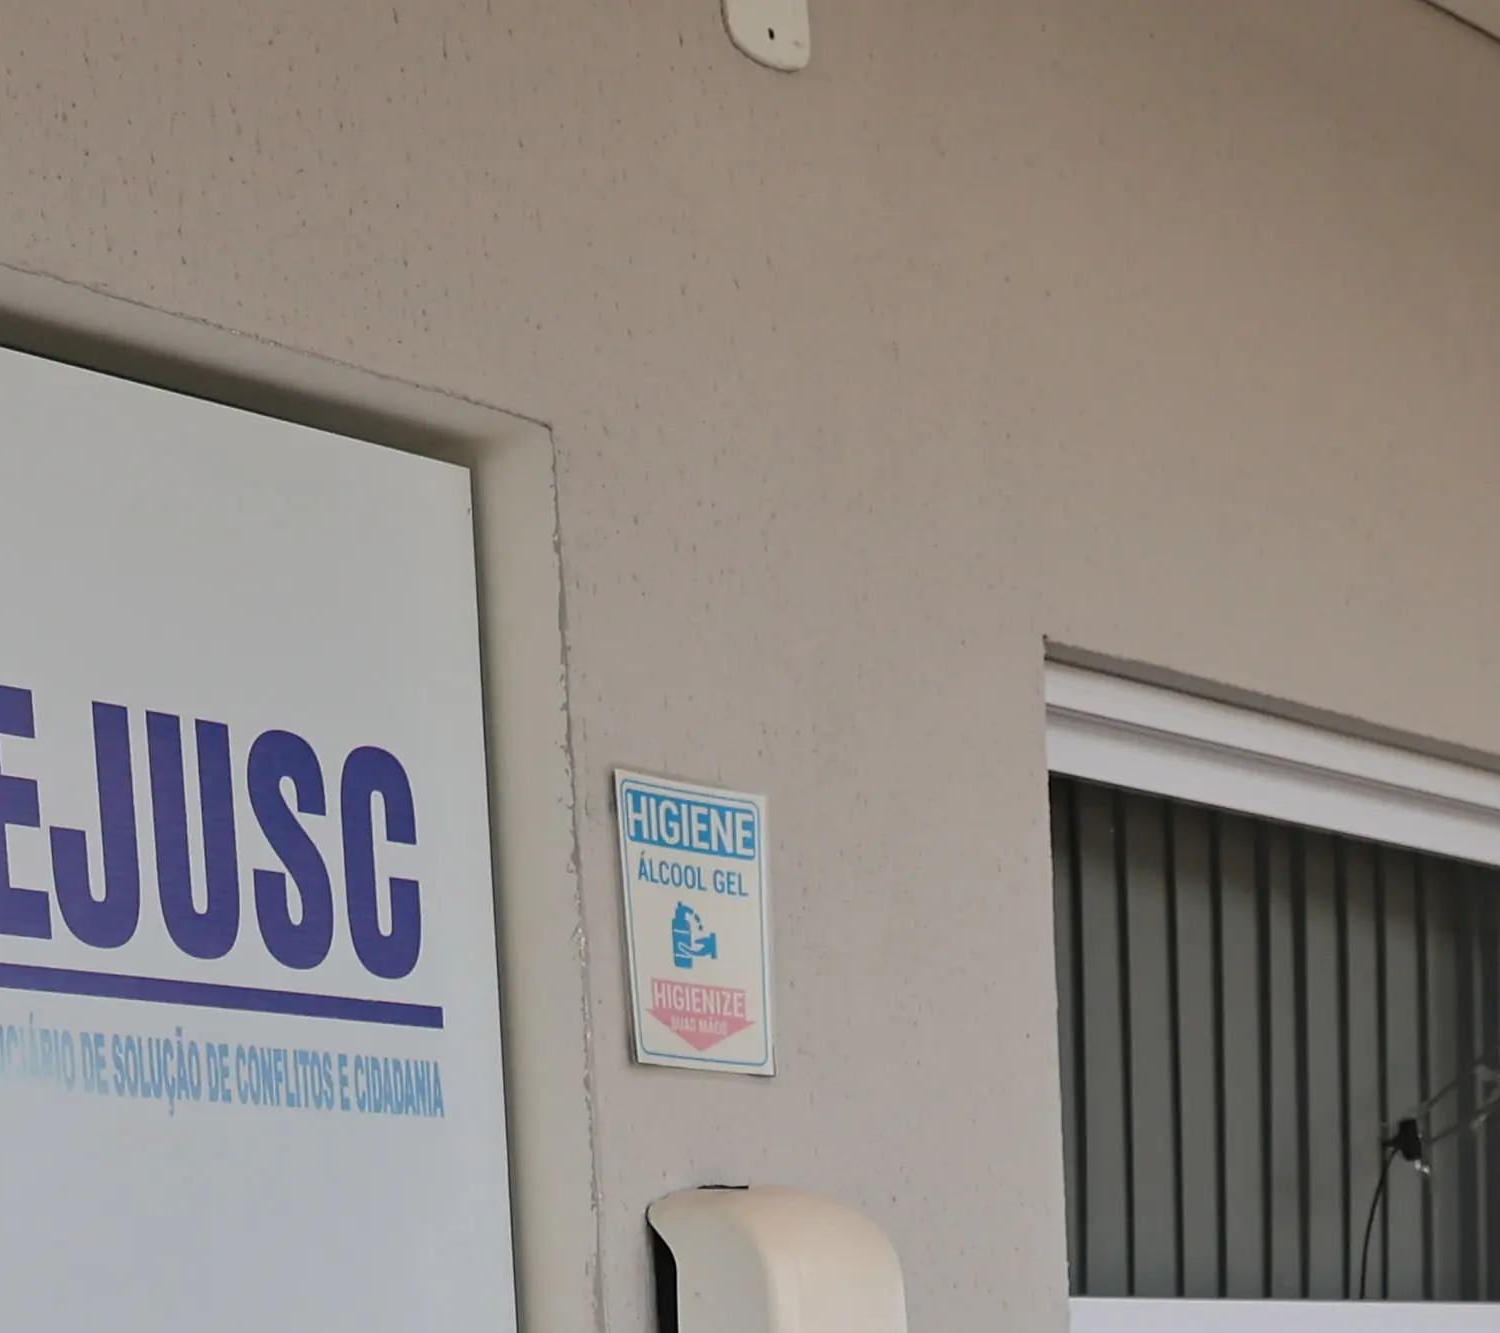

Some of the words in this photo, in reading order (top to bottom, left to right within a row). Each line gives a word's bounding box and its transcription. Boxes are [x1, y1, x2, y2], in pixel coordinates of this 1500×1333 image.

[625, 792, 756, 857] HIGIENE
[637, 851, 707, 891] ÁLCOOL
[712, 869, 749, 897] GEL
[653, 981, 745, 1018] HIGIENIZE
[79, 1031, 110, 1096] DE
[111, 1026, 201, 1117] SOLUÇÃO
[205, 1042, 233, 1104] DE
[235, 1044, 334, 1112] CONFLITOS
[337, 1053, 351, 1112] E
[353, 1054, 445, 1118] CIDADANIA
